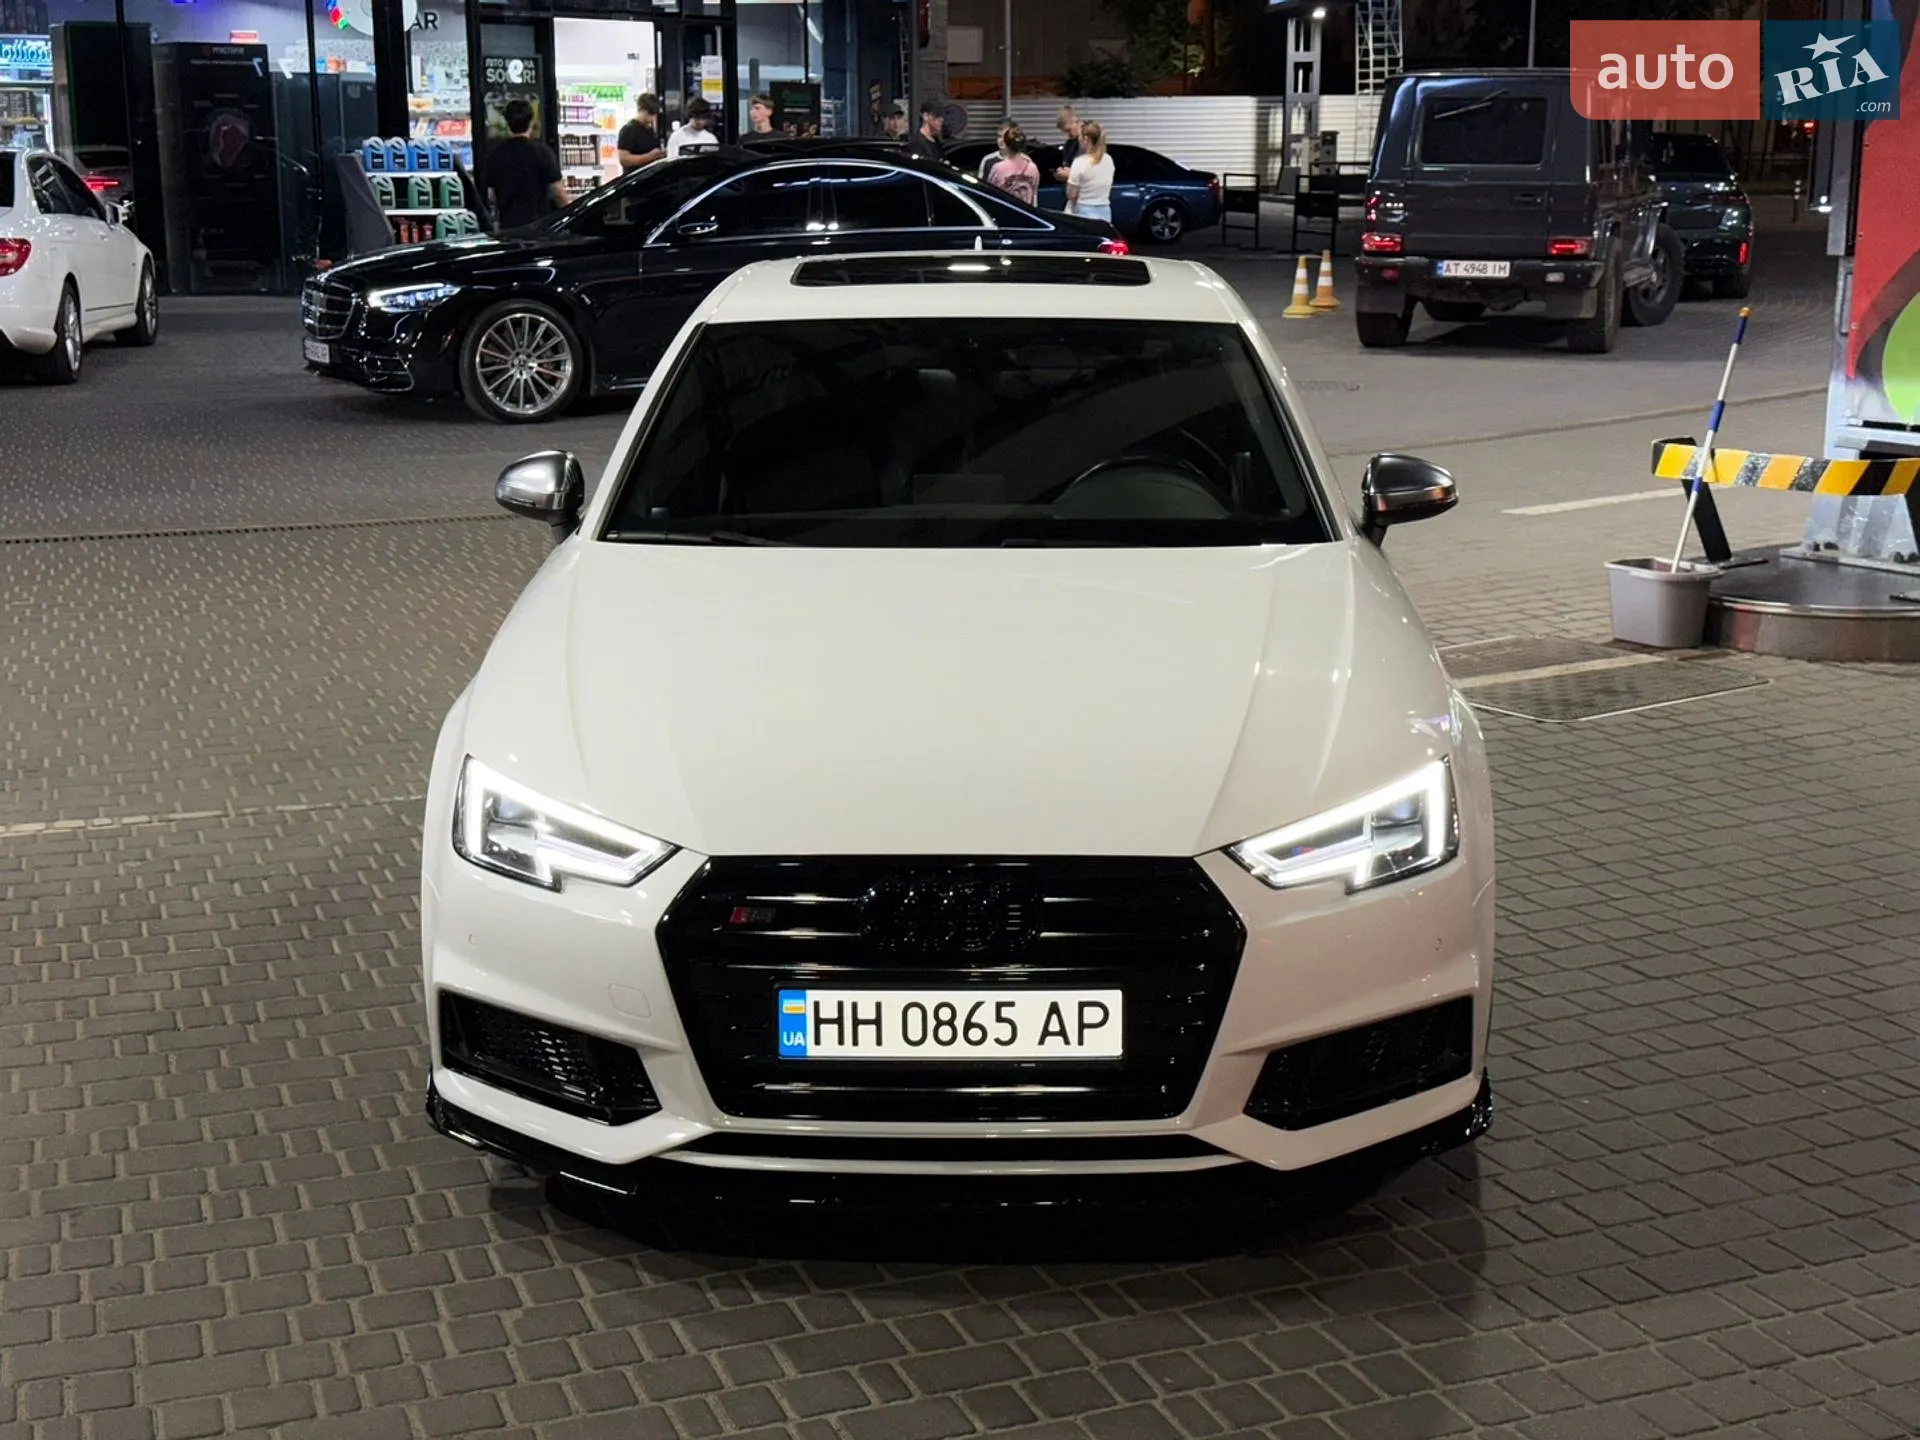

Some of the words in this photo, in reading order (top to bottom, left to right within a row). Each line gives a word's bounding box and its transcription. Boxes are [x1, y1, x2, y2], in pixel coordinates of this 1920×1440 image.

[486, 68, 536, 84] SOR!
[1445, 262, 1460, 274] AT
[1463, 262, 1488, 274] 4948
[1492, 263, 1507, 275] IM
[813, 1000, 883, 1047] HH
[901, 1001, 1018, 1047] 0865
[1037, 1001, 1110, 1046] AP
[783, 1031, 807, 1047] UA
